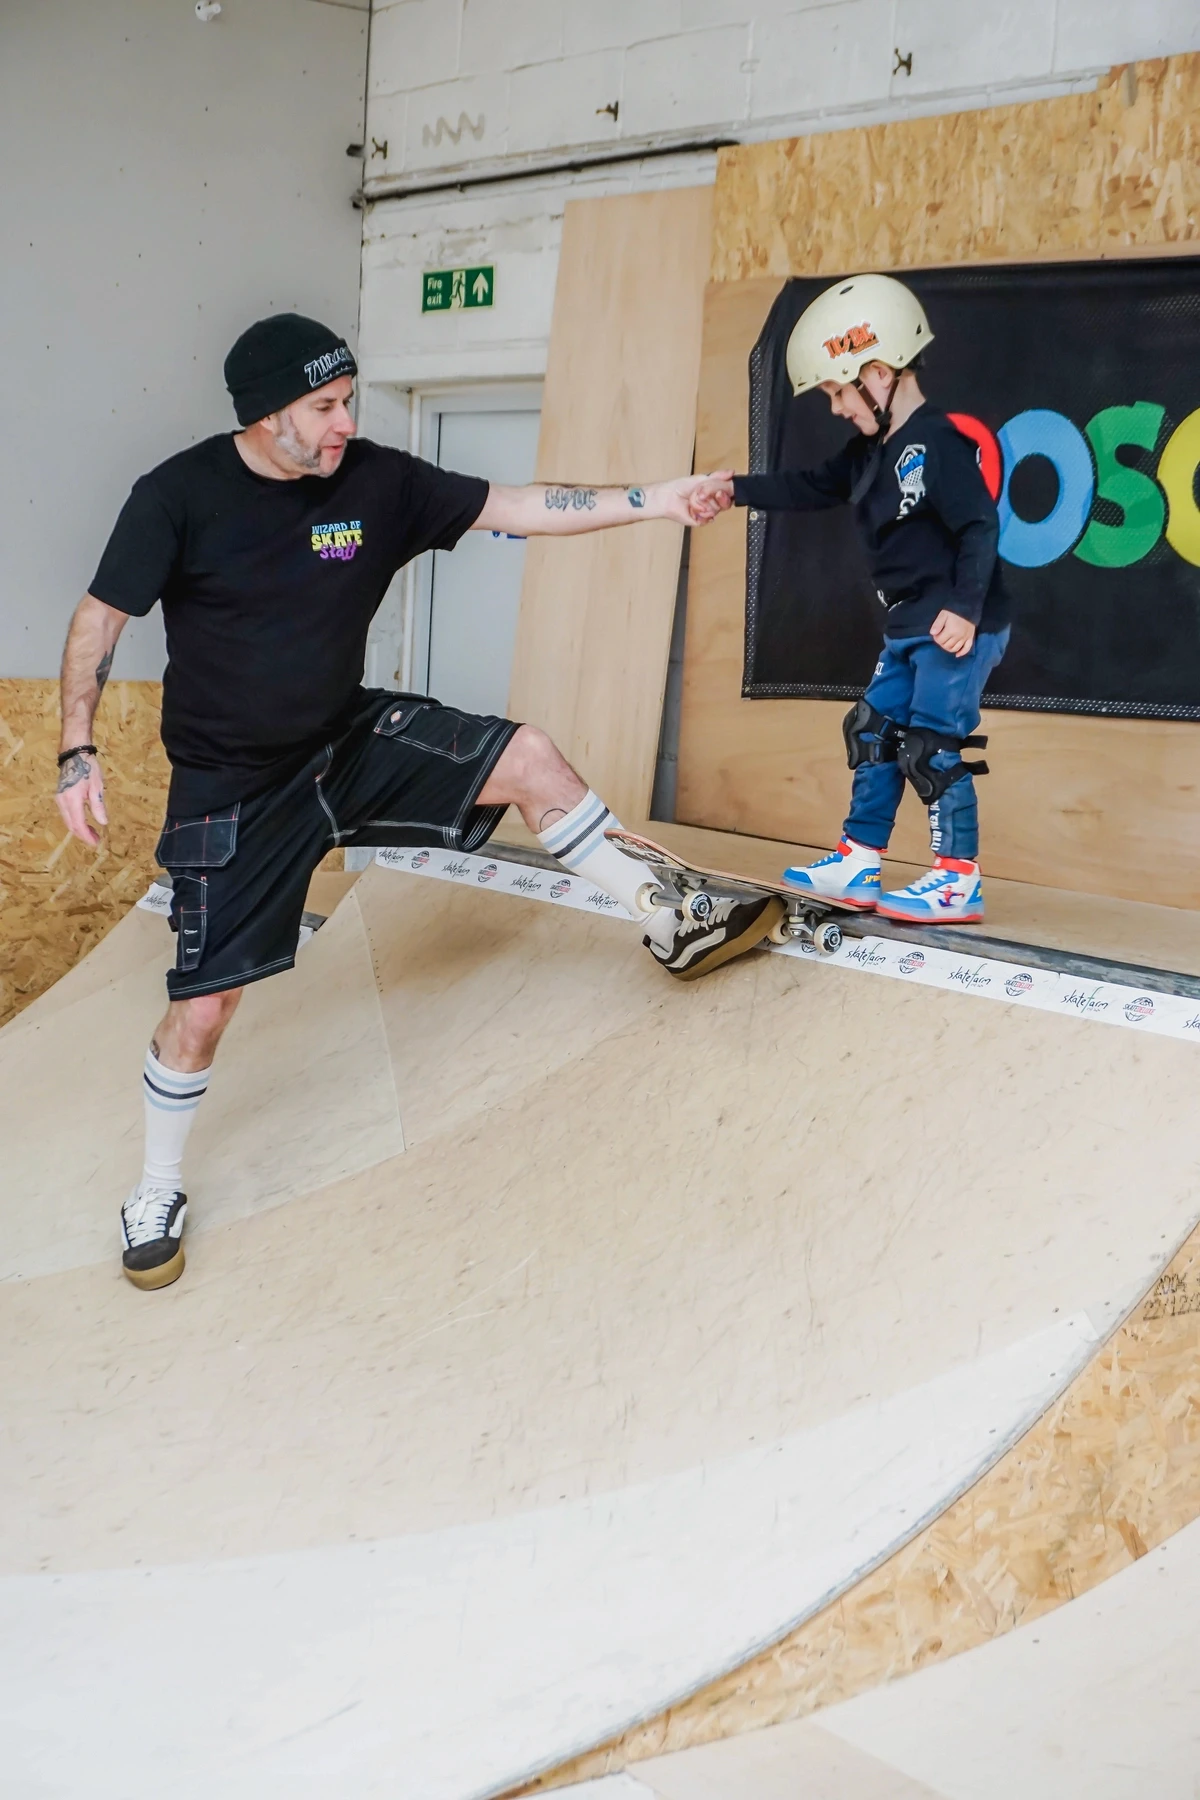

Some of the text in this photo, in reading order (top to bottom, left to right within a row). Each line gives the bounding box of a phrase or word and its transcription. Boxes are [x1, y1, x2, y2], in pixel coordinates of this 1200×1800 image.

[427, 277, 442, 290] Fire
[427, 293, 442, 306] exit
[311, 520, 361, 535] WIZARD OF
[311, 529, 363, 552] SKATE
[845, 942, 886, 967] skatefarm
[947, 962, 991, 989] skatefarm
[1060, 986, 1109, 1013] skatefarm
